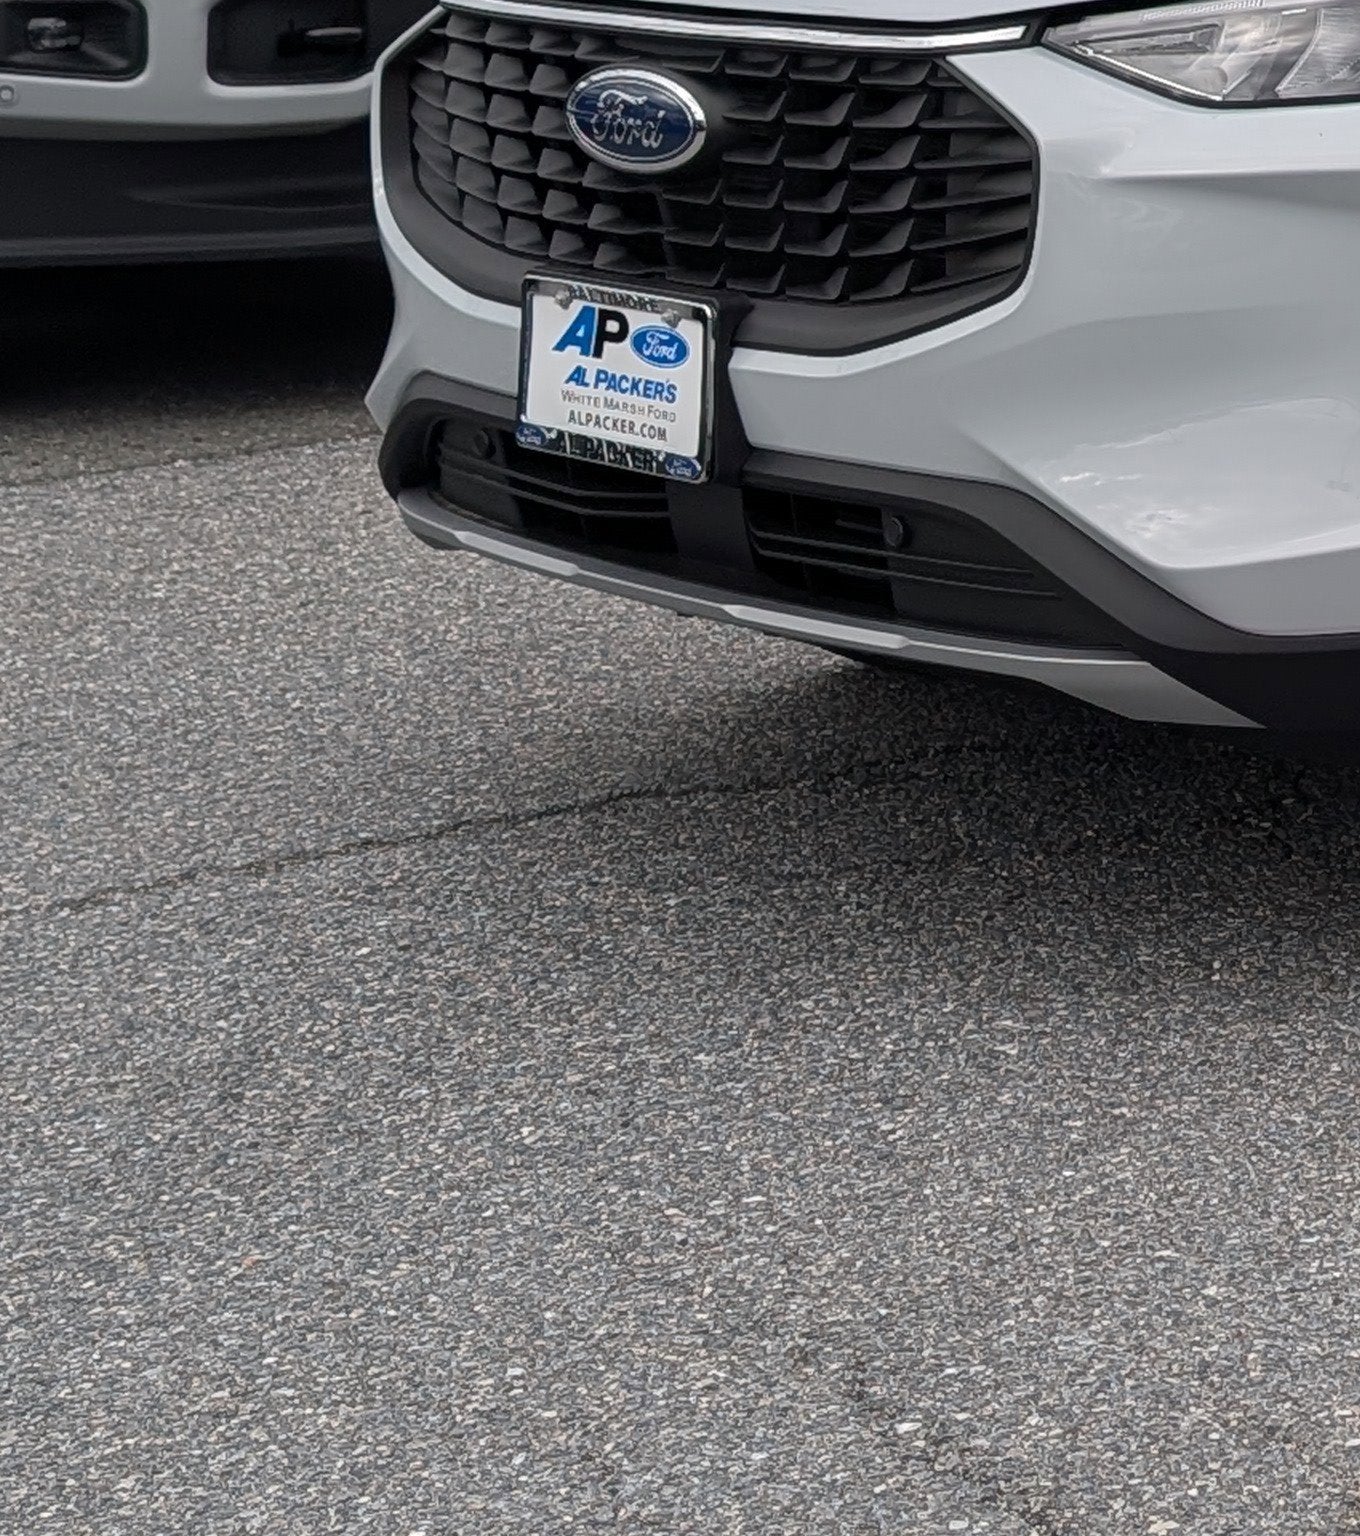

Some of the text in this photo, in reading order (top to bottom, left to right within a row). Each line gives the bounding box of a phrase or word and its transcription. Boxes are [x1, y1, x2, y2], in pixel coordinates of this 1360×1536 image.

[590, 89, 667, 149] Ford
[552, 305, 679, 361] AP Ford
[564, 365, 678, 404] AL PACKER'S
[567, 409, 668, 442] ALPACKER.COM
[603, 395, 646, 417] MARSH
[647, 404, 677, 423] FORD
